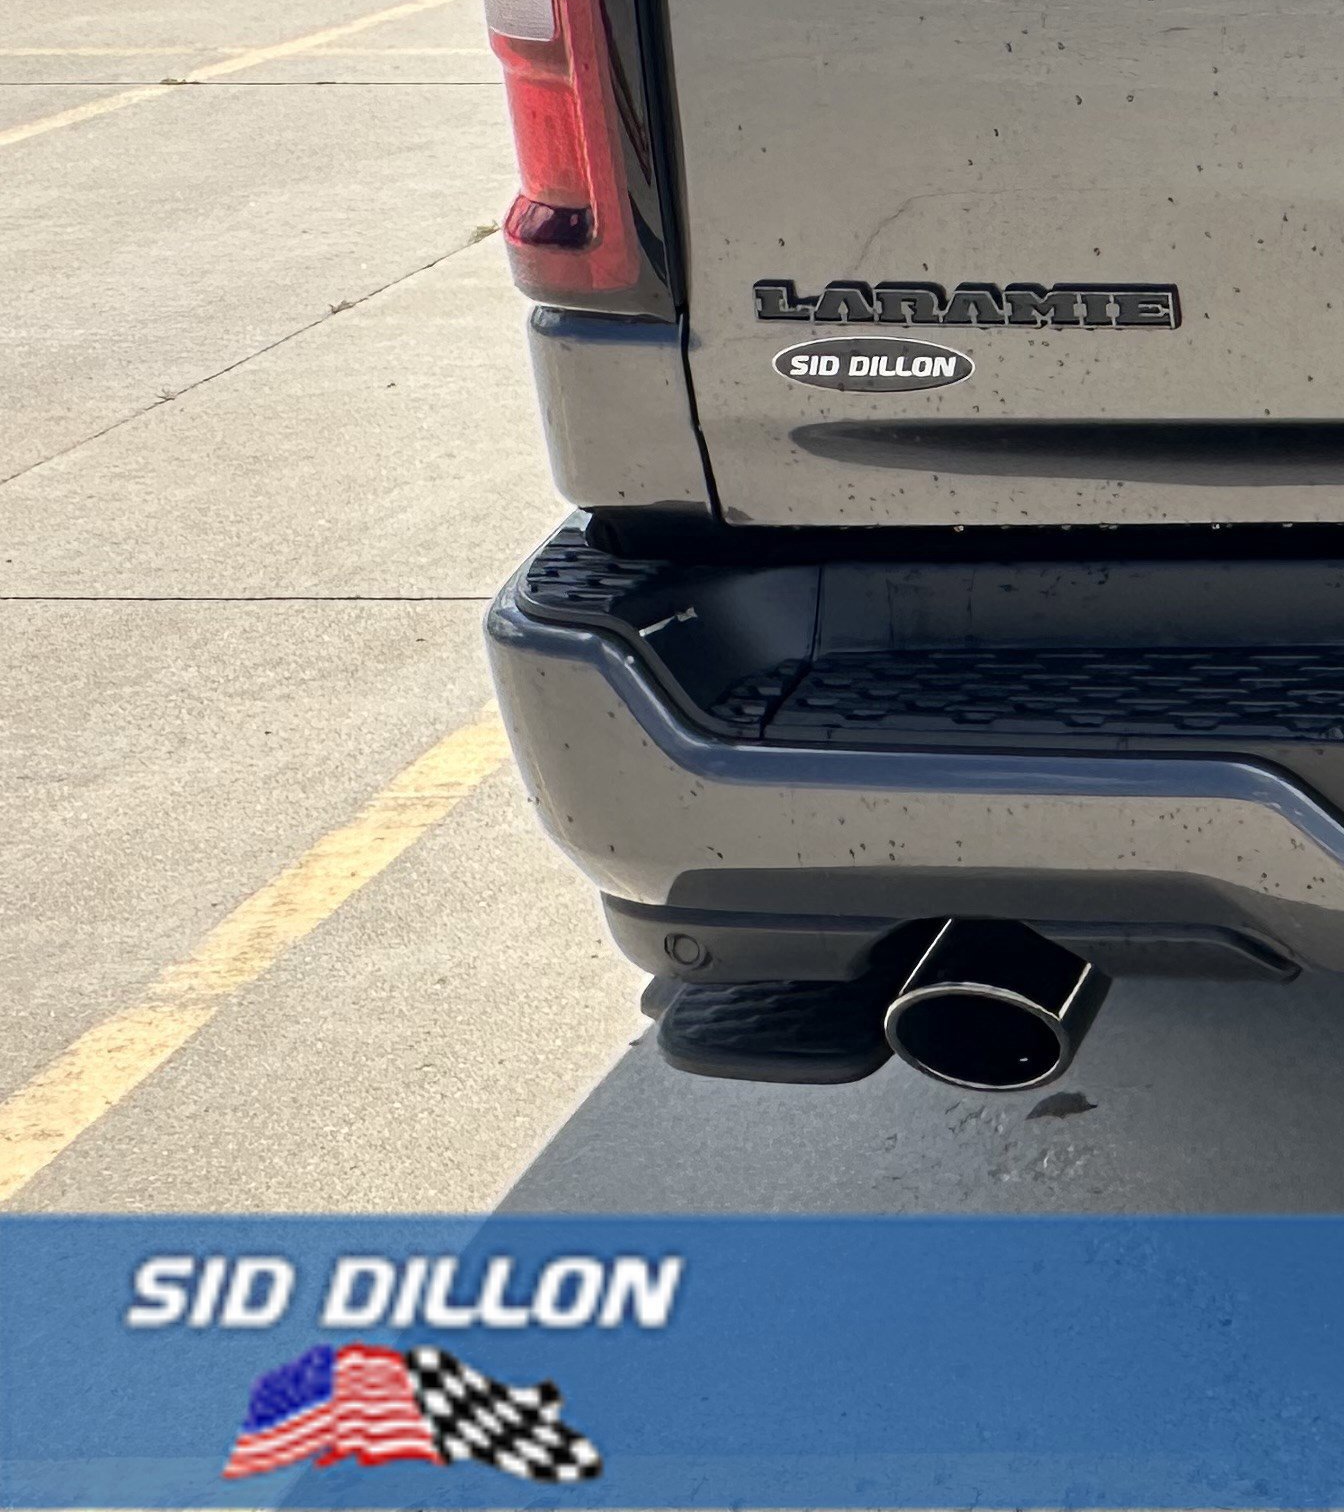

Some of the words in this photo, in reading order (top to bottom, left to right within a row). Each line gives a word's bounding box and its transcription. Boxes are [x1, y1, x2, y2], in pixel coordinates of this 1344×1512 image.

[753, 279, 1182, 330] LARAMIE
[789, 355, 840, 376] SID
[848, 355, 957, 377] DILLON
